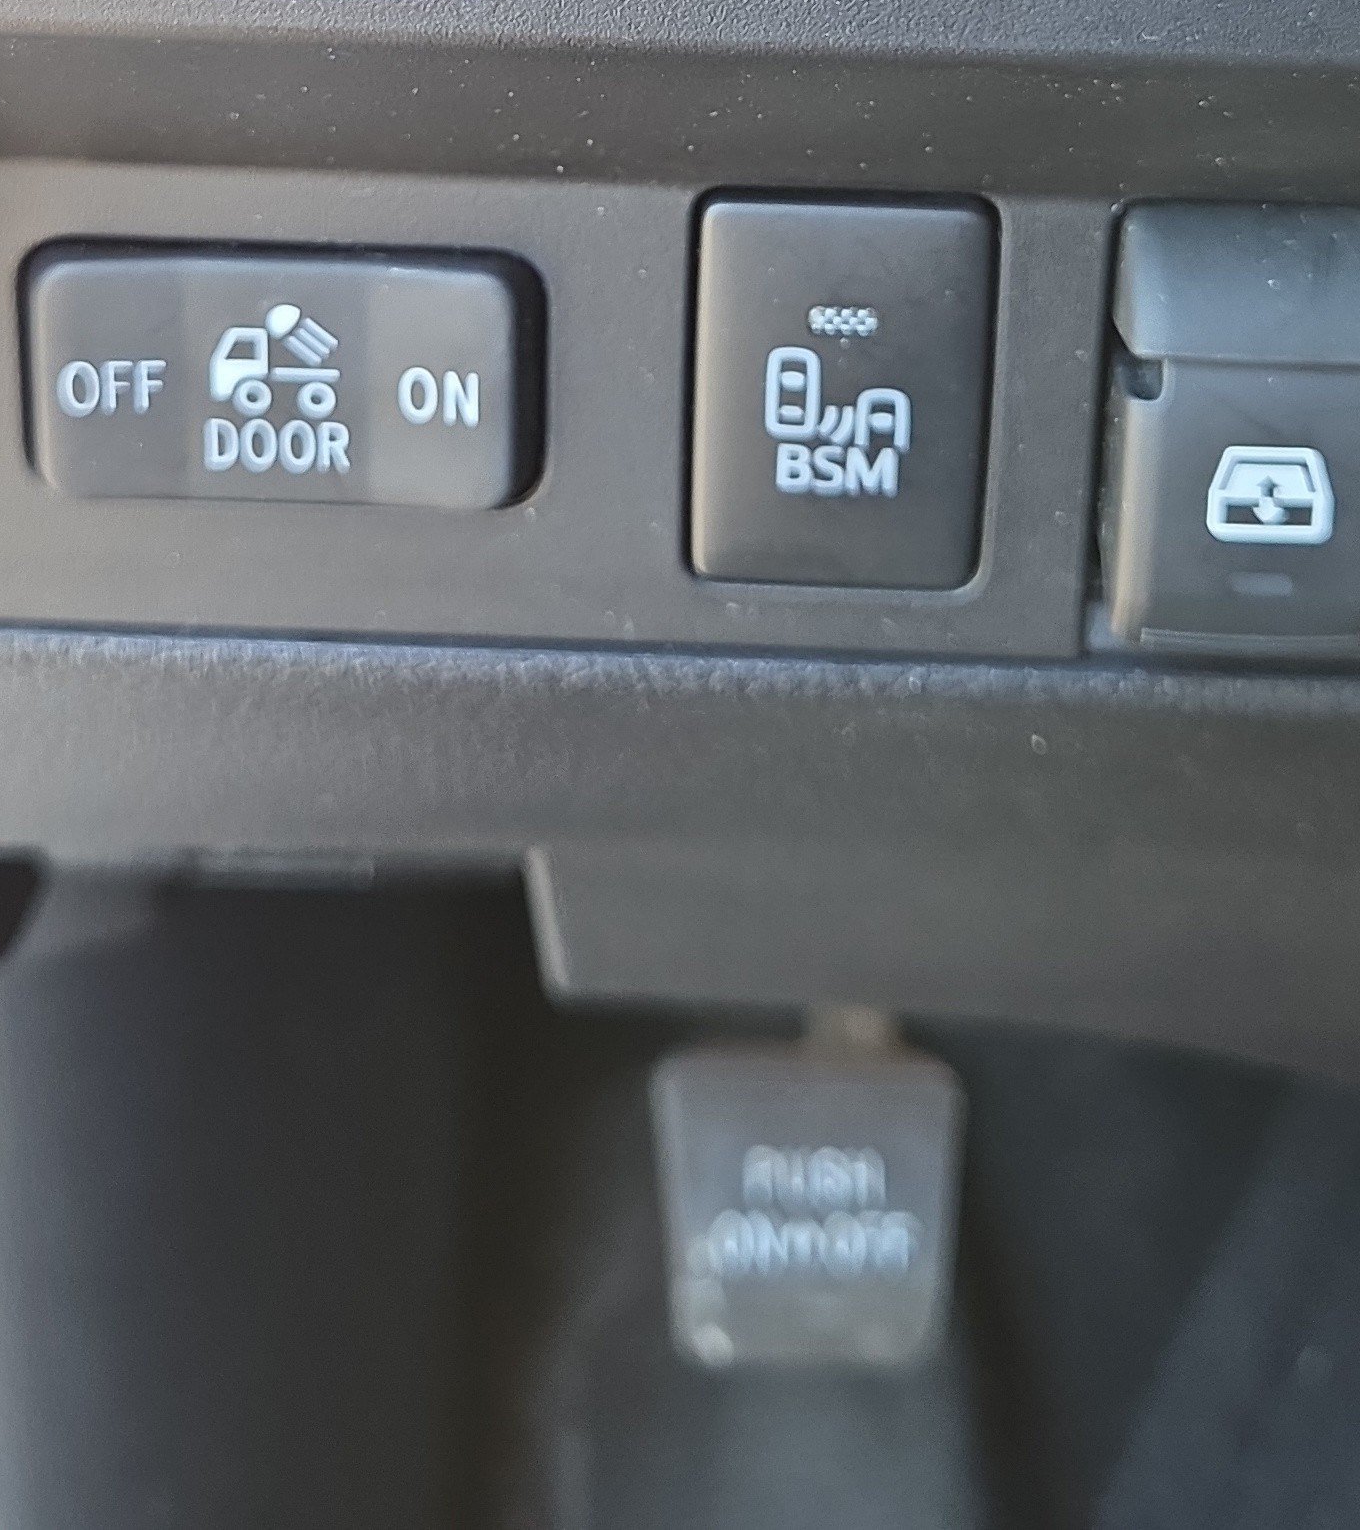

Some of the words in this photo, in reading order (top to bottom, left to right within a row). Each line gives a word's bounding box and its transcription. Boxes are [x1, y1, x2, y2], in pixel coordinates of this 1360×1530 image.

[56, 359, 167, 417] OFF
[397, 366, 480, 427] ON
[203, 417, 351, 474] DOOR
[775, 442, 900, 497] BSM
